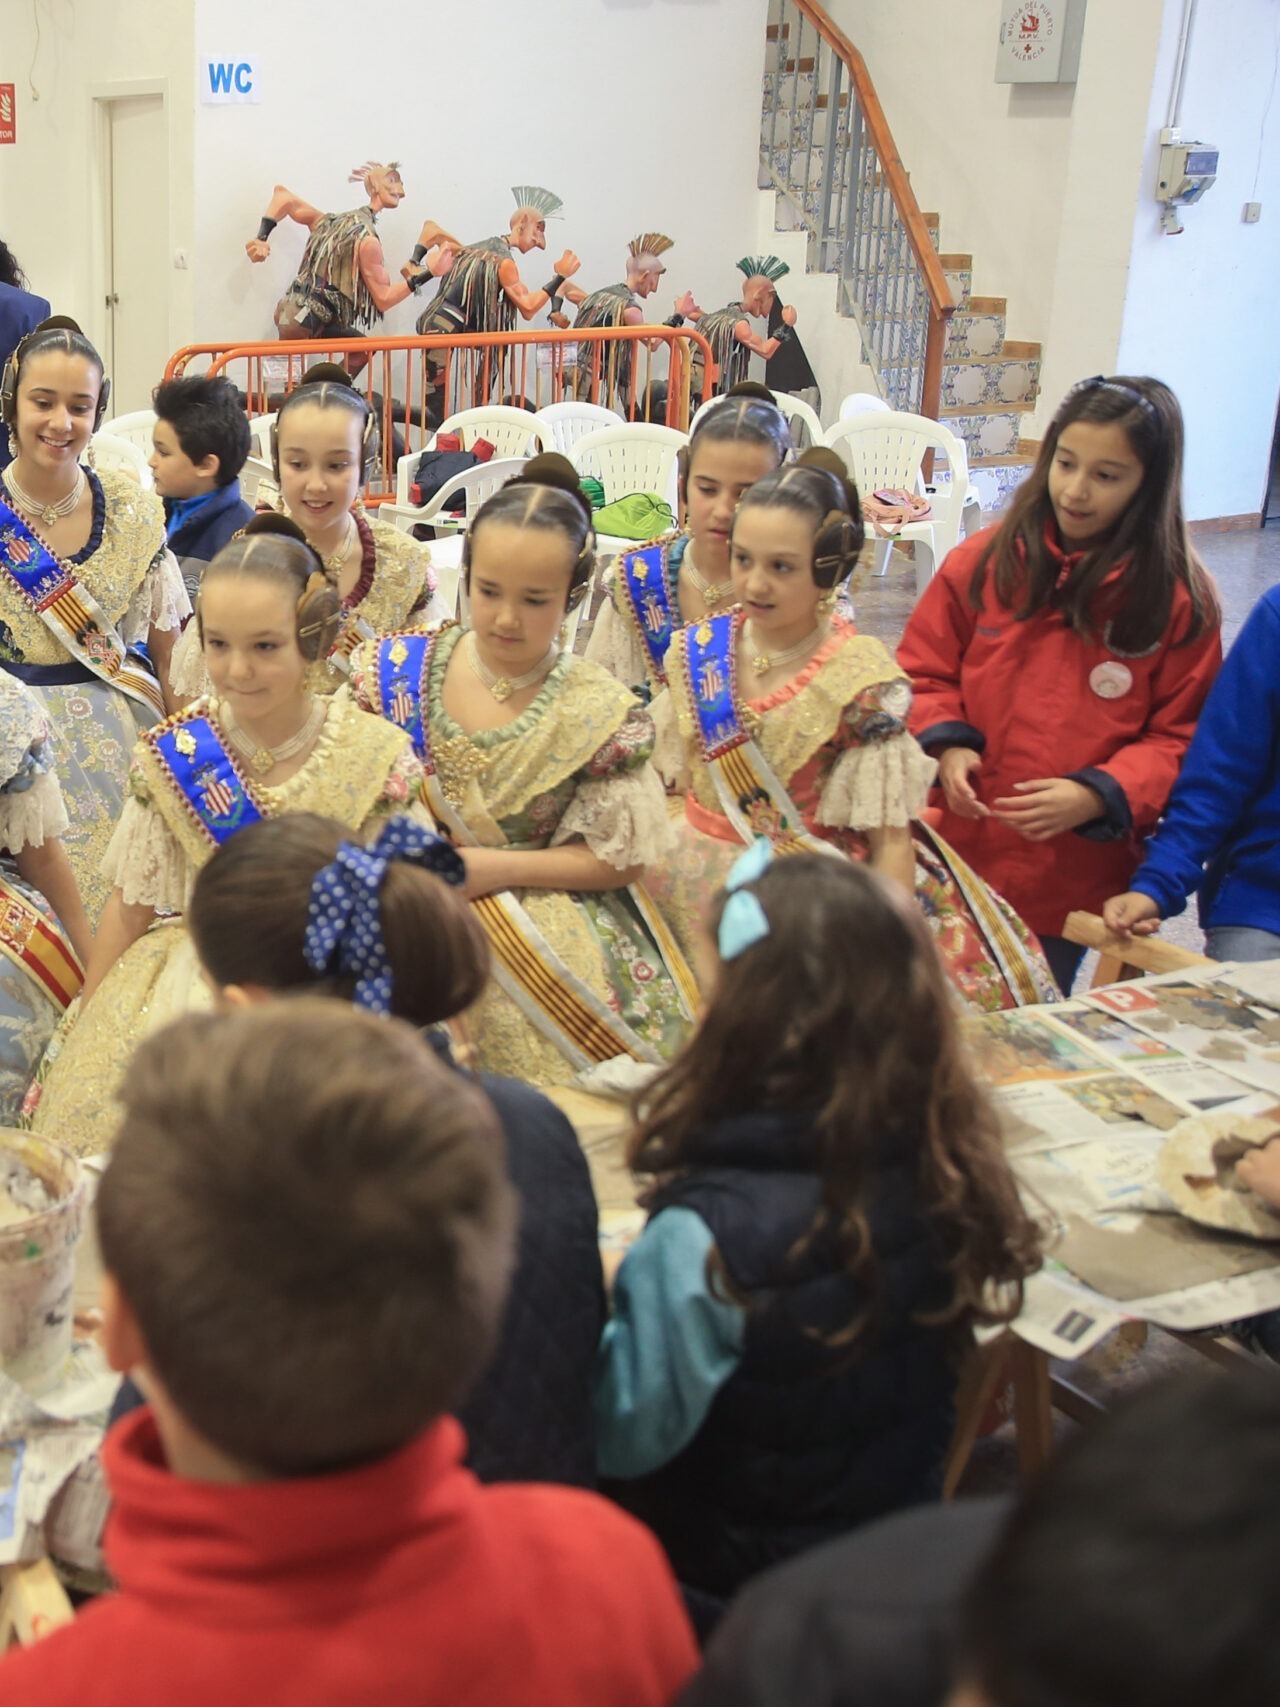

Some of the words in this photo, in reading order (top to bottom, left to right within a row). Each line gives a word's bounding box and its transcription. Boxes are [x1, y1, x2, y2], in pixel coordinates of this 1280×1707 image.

[1007, 8, 1023, 37] MUTUA
[1024, 1, 1037, 10] DEL
[1039, 3, 1054, 36] PUERTO
[1011, 46, 1045, 61] VALENCIA
[208, 63, 253, 94] WC
